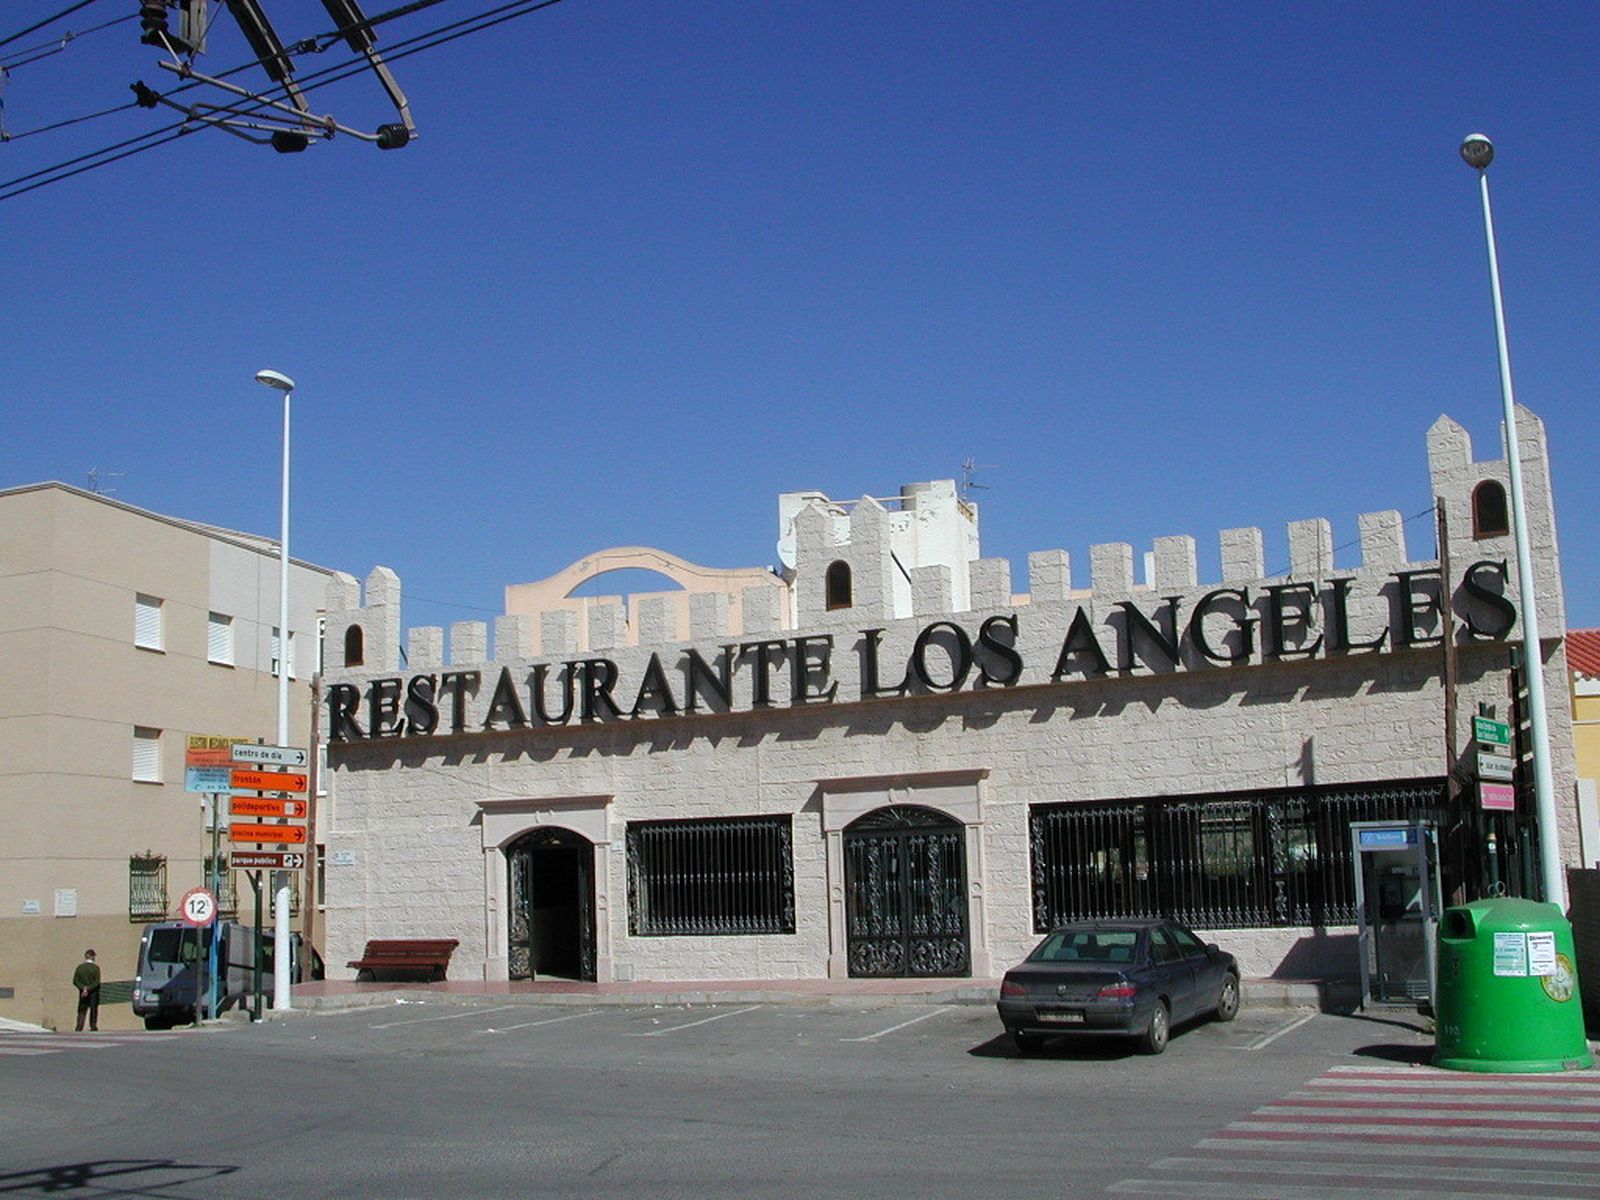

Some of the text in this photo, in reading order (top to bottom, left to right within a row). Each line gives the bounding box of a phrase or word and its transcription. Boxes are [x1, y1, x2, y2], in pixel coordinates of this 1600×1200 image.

[325, 558, 1517, 742] RESTAURANTE LOS ANGELES
[233, 748, 258, 758] centro
[260, 750, 270, 759] de
[232, 802, 280, 812] polideportivo
[232, 830, 253, 838] piscina
[232, 856, 254, 865] parque
[189, 900, 206, 914] 12
